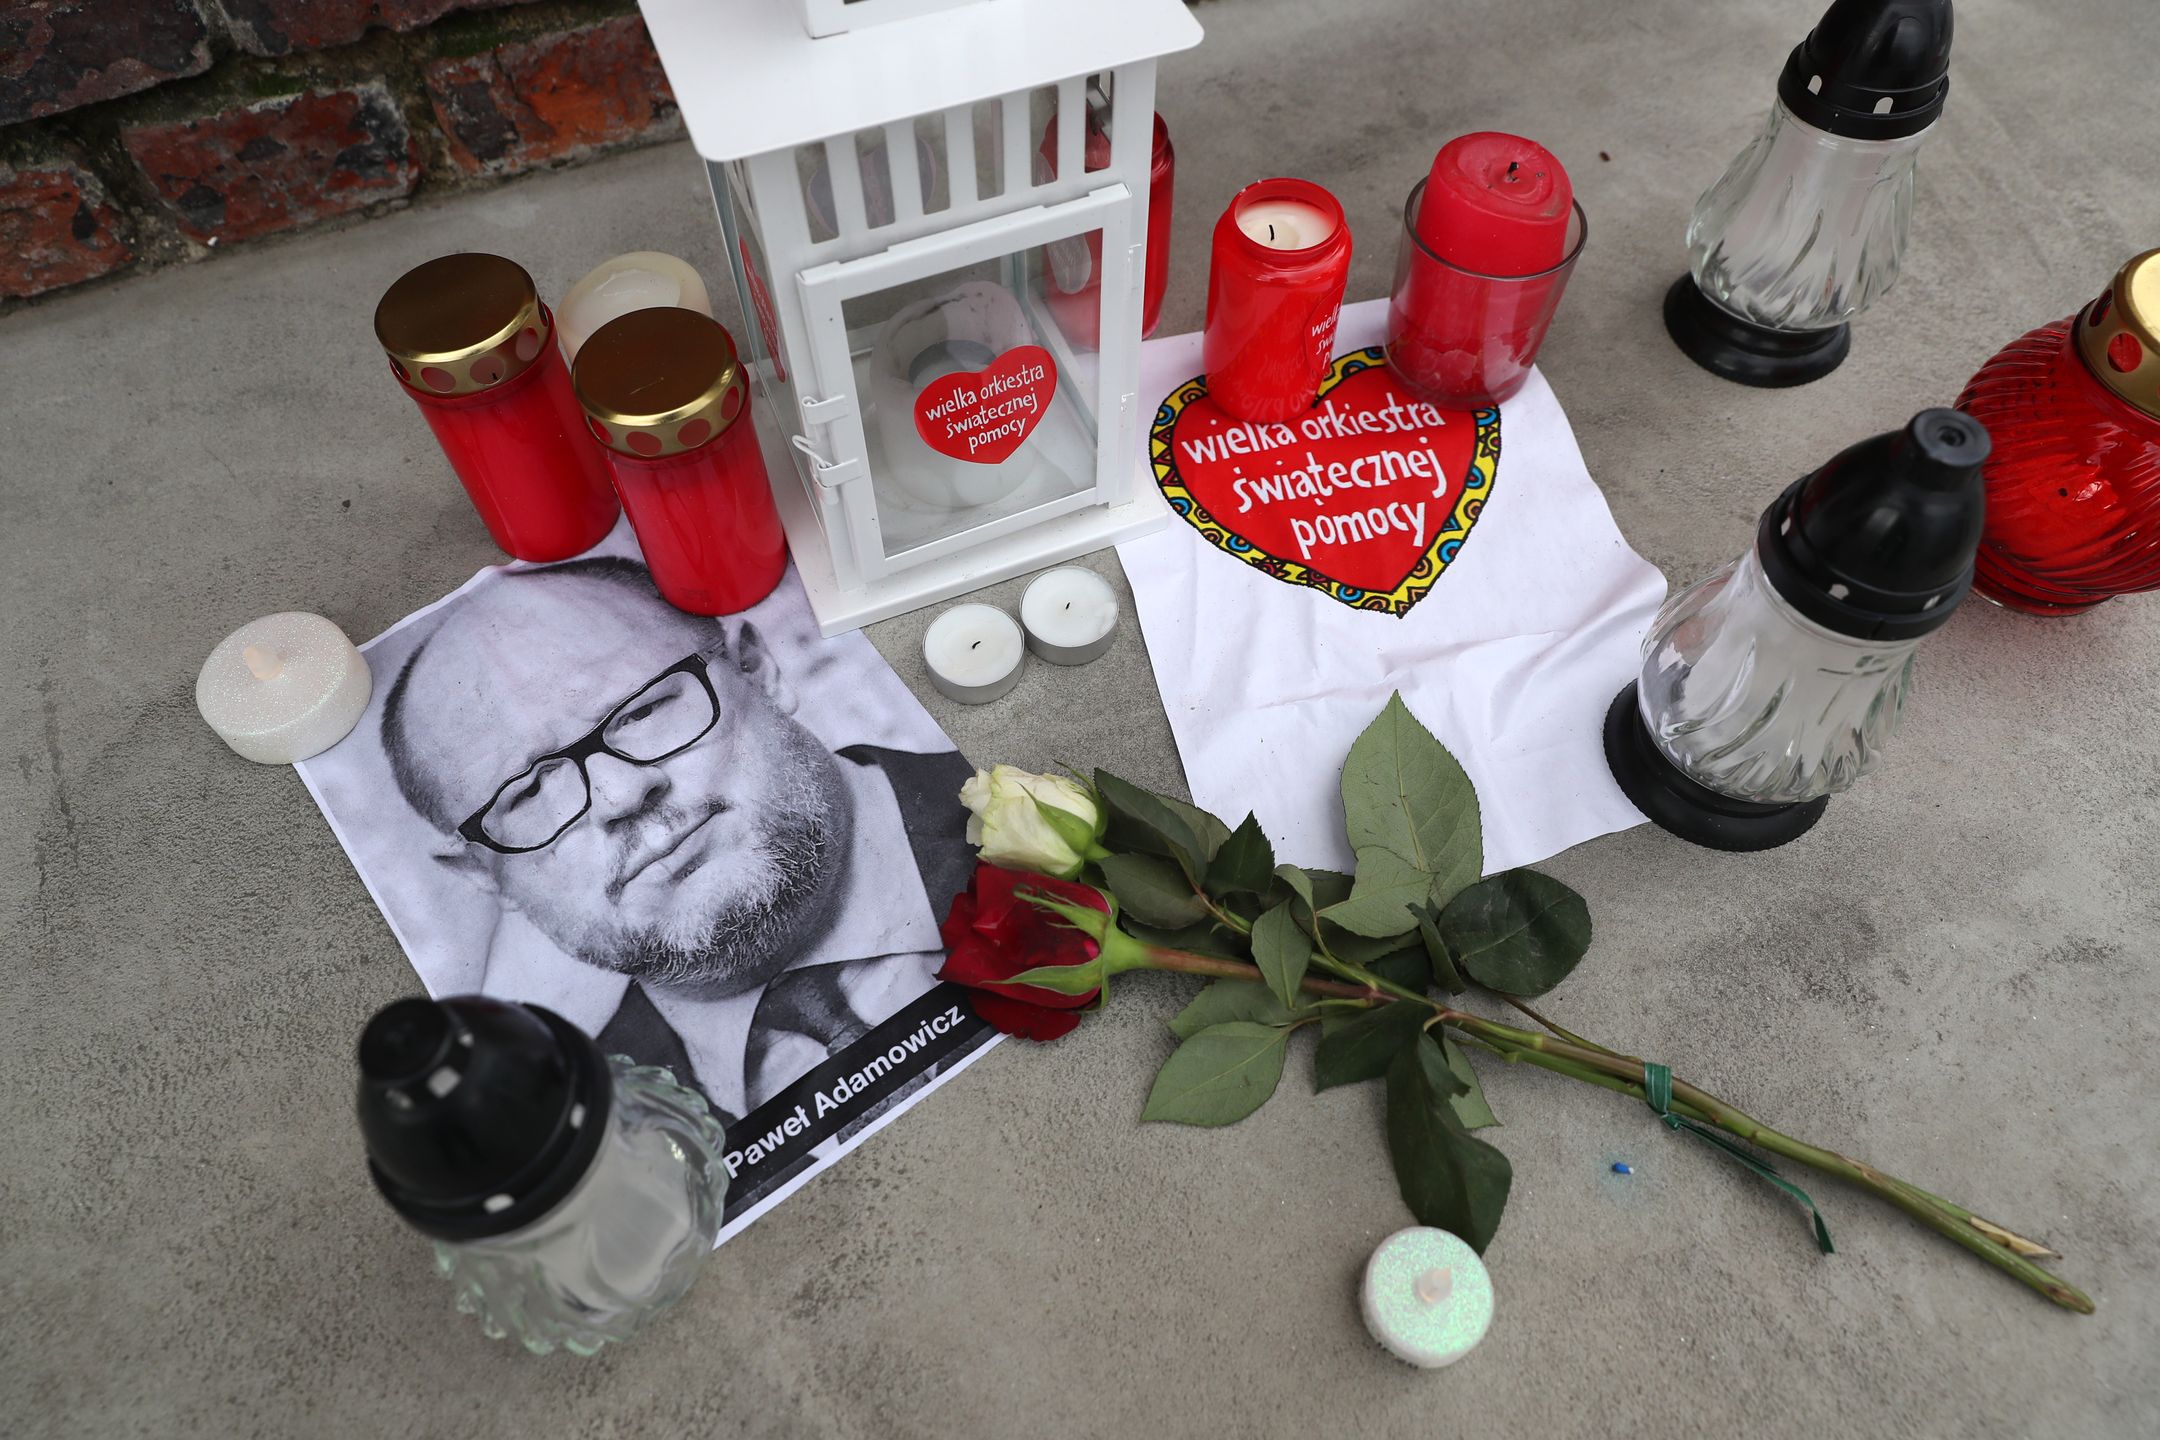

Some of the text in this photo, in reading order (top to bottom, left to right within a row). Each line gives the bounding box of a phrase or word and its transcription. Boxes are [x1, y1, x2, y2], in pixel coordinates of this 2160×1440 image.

[925, 364, 1045, 421] wielka orkiestra
[946, 387, 1038, 439] świątecznej
[968, 417, 1026, 455] pomocy
[1181, 392, 1446, 465] wielka orkiestra
[1232, 436, 1448, 514] świątecznej
[1290, 501, 1426, 560] pomocy
[722, 1005, 966, 1180] Paweł Adamowicz
